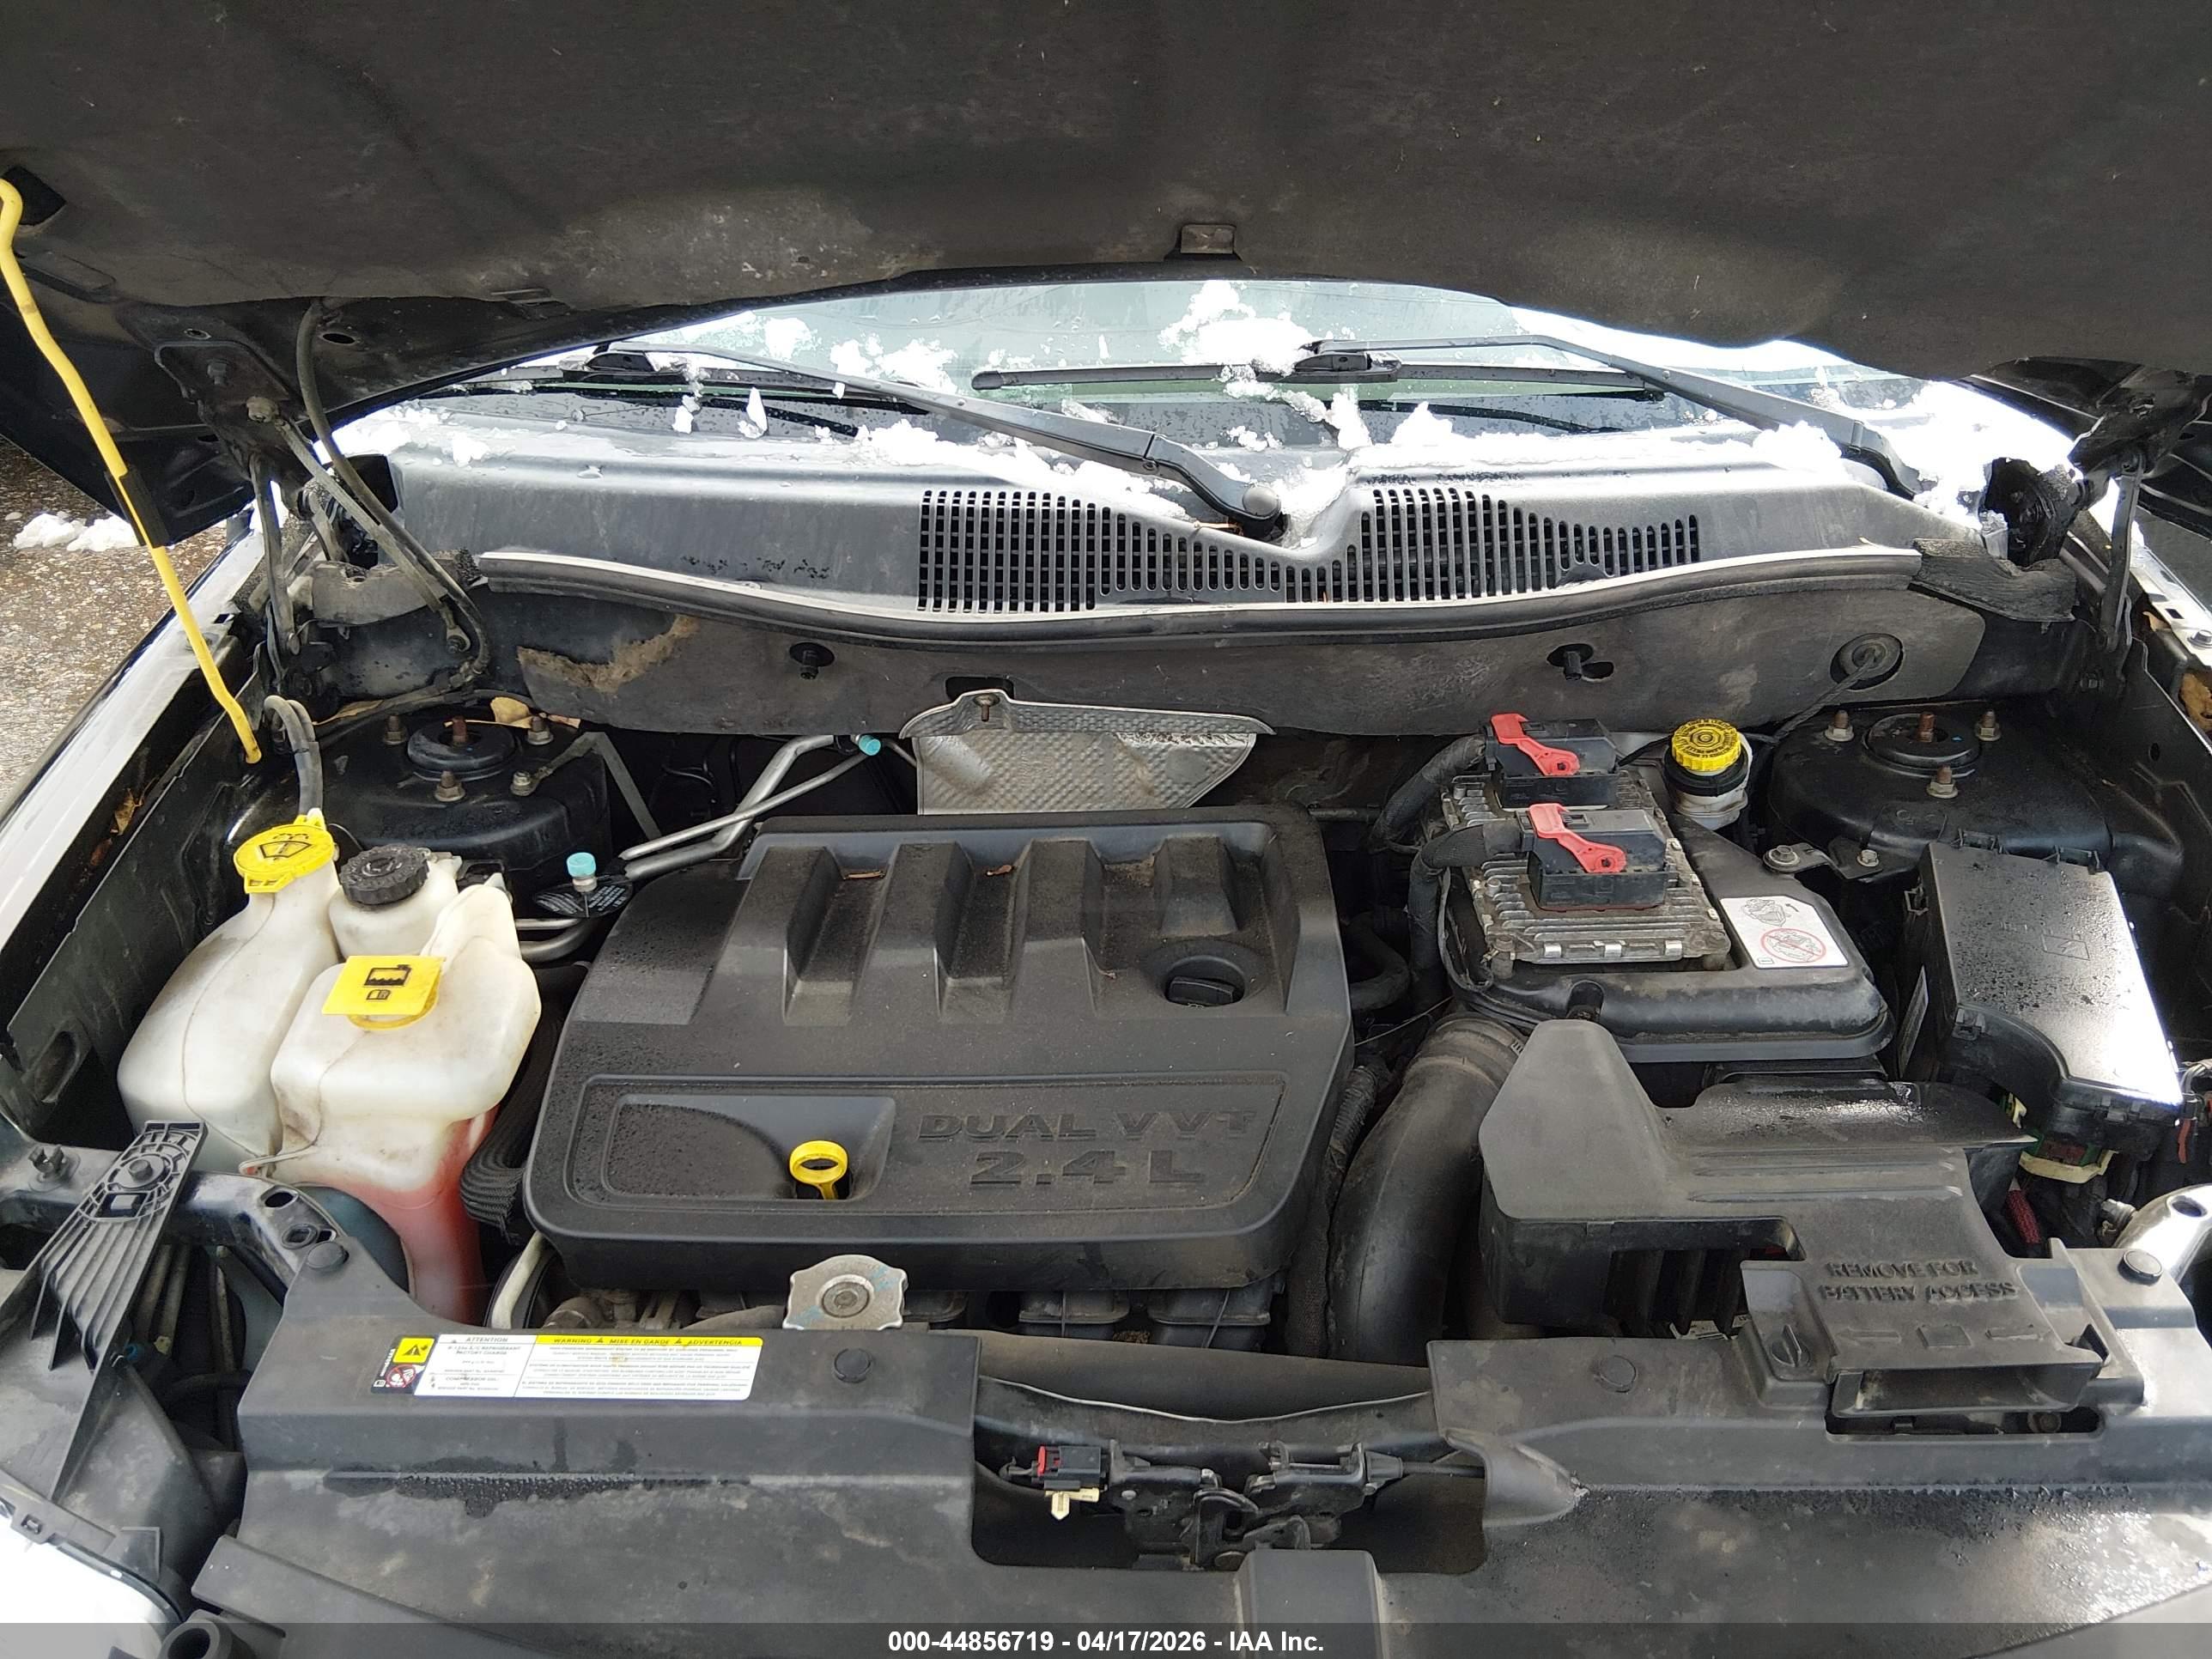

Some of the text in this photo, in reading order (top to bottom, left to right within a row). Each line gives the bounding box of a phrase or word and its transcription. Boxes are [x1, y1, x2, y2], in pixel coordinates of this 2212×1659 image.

[917, 1111, 1255, 1140] DUAL VVT
[1825, 1259, 1978, 1279] REMOVE FOR
[1818, 1282, 2017, 1302] BATTERY ACCESS
